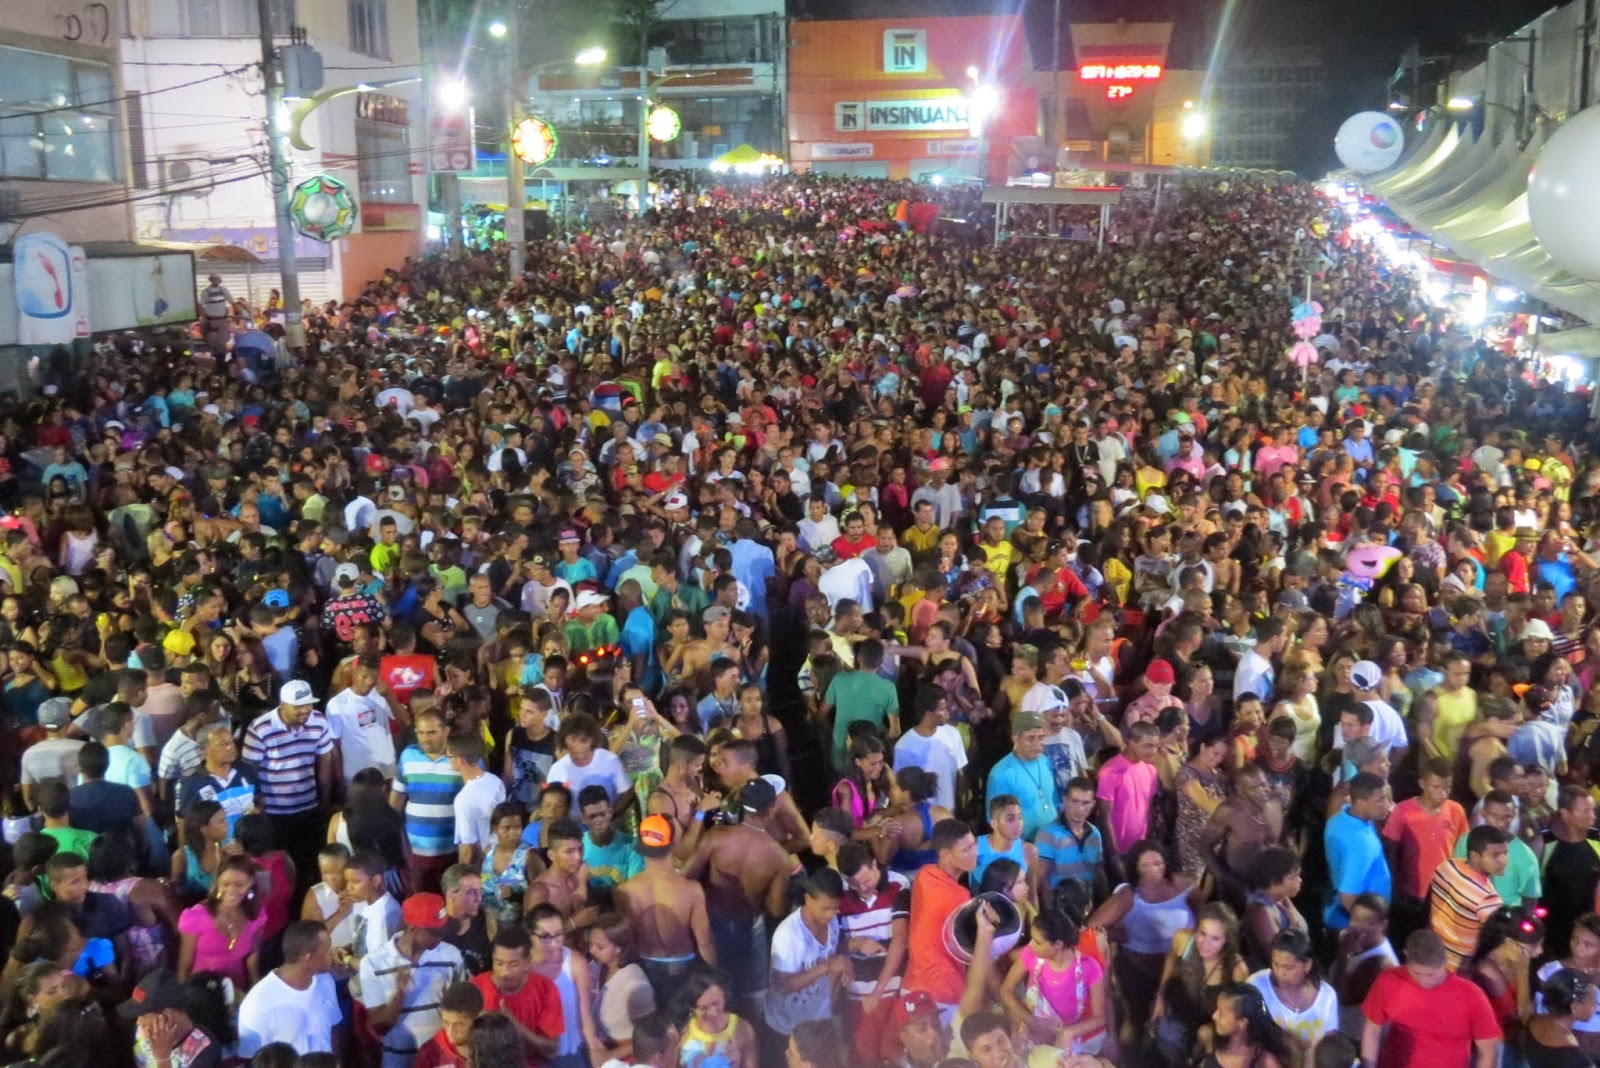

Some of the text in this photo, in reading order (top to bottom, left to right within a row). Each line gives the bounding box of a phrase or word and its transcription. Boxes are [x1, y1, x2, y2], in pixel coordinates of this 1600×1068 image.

[894, 45, 915, 66] IN
[842, 106, 974, 127] IN INSINUAN
